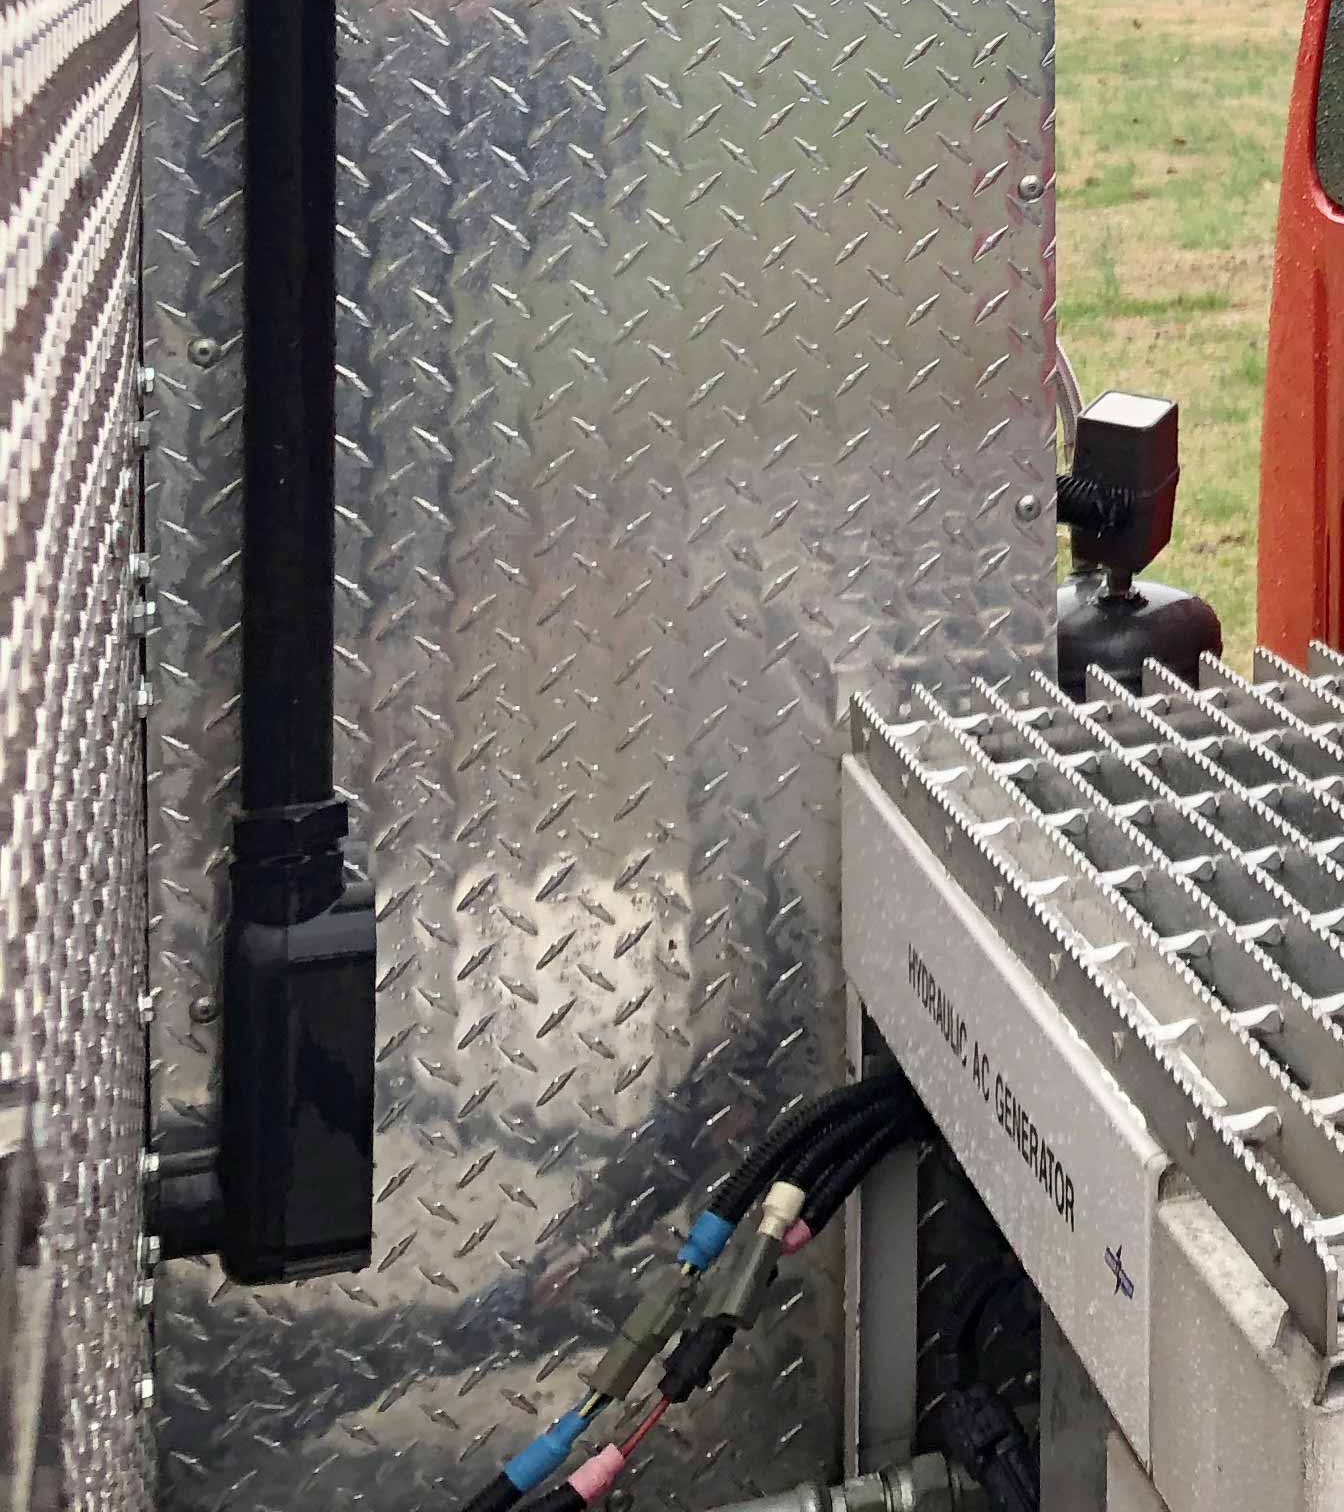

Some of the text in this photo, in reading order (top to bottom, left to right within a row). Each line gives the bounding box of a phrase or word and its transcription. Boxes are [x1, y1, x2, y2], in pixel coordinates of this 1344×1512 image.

[908, 943, 1075, 1233] HYDRAULIC AC GENERATOR
